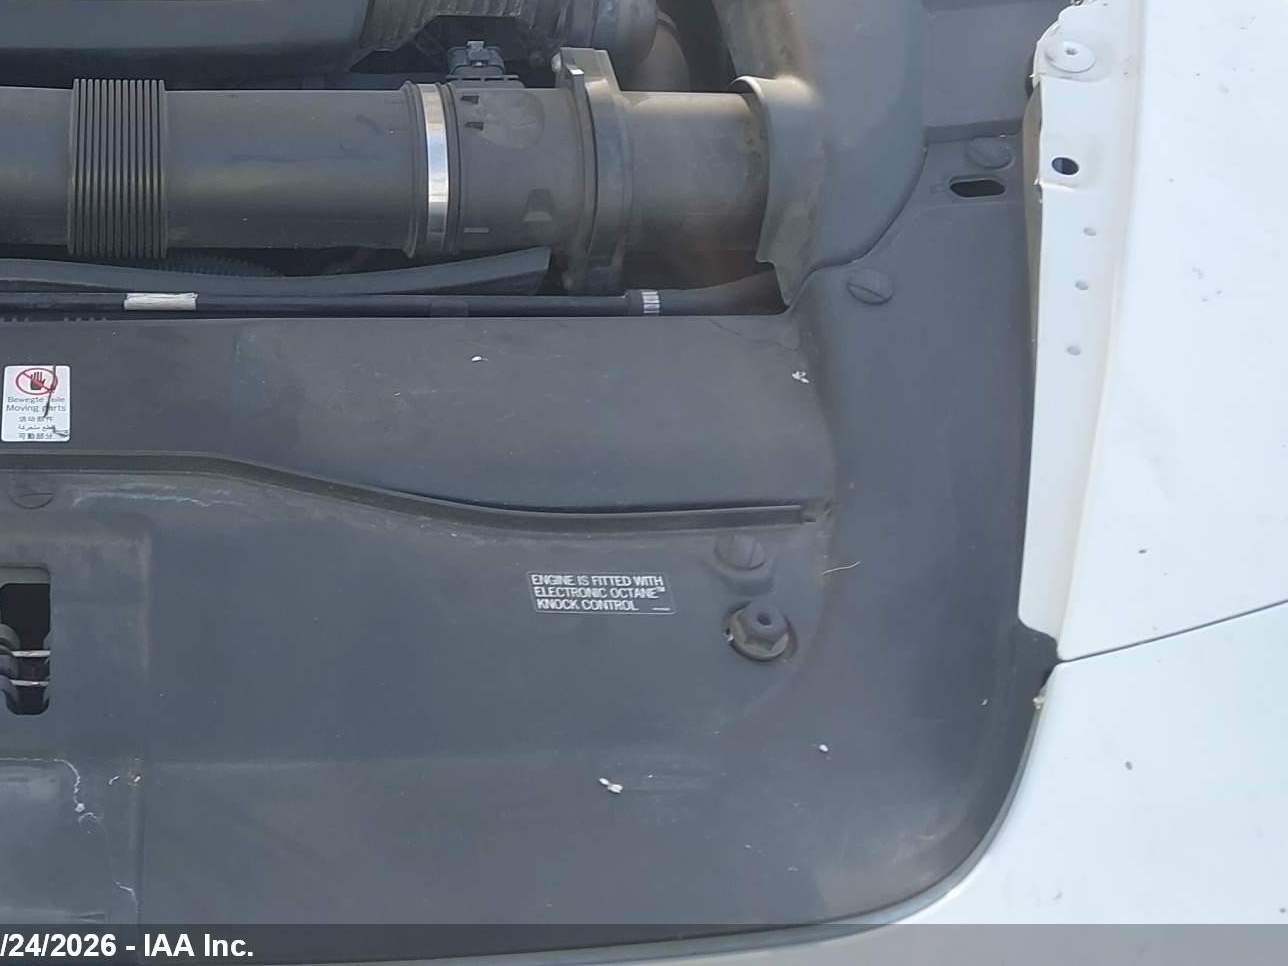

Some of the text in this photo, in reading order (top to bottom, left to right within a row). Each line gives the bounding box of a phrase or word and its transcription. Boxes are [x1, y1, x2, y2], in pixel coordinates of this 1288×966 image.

[6, 404, 40, 413] Moving
[532, 575, 664, 587] ENGINE IS FITTED WITH
[534, 586, 608, 598] ELECTRONIC
[536, 598, 639, 611] KNOCK CONTROL
